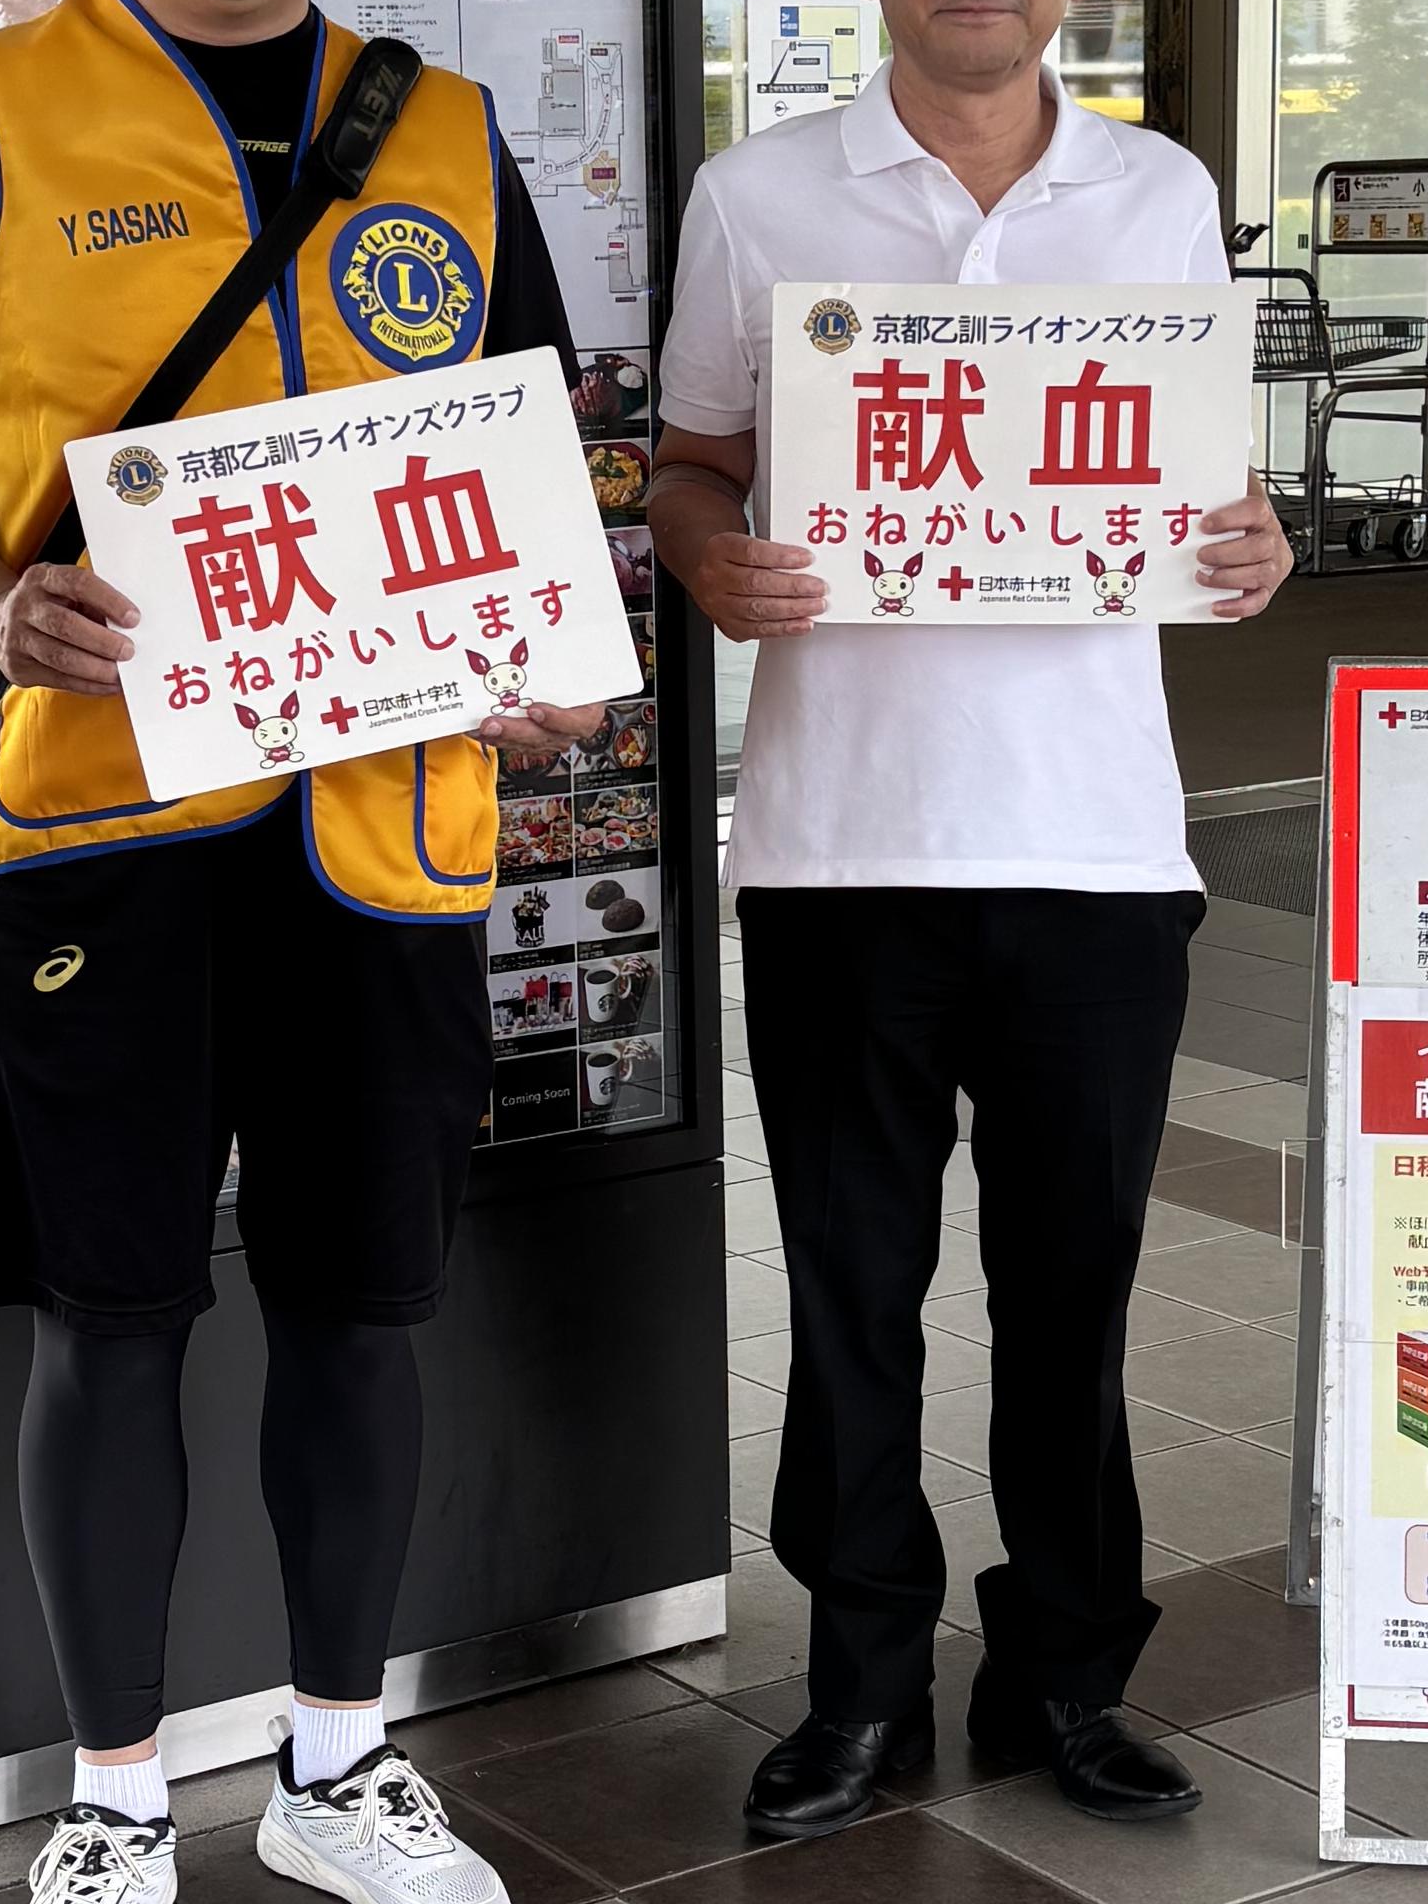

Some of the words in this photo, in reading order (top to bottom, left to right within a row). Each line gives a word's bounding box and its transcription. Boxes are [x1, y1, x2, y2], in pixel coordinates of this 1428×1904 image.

[58, 201, 190, 256] Y.SASAKI
[368, 222, 444, 257] LIONS
[393, 262, 428, 312] L
[378, 319, 450, 354] INTERNATIONAL
[872, 313, 1217, 345] 京都乙訓ライオンズクラブ
[177, 385, 526, 485] 京都乙訓ライオンズクラブ
[853, 358, 1161, 491] 献血
[806, 502, 1204, 546] おねがいします
[172, 456, 520, 642] 献血
[979, 576, 1070, 592] 日本赤十字社
[163, 580, 571, 709] おねがいします
[363, 681, 461, 717] 日本赤十字社
[501, 1091, 541, 1106] Coming
